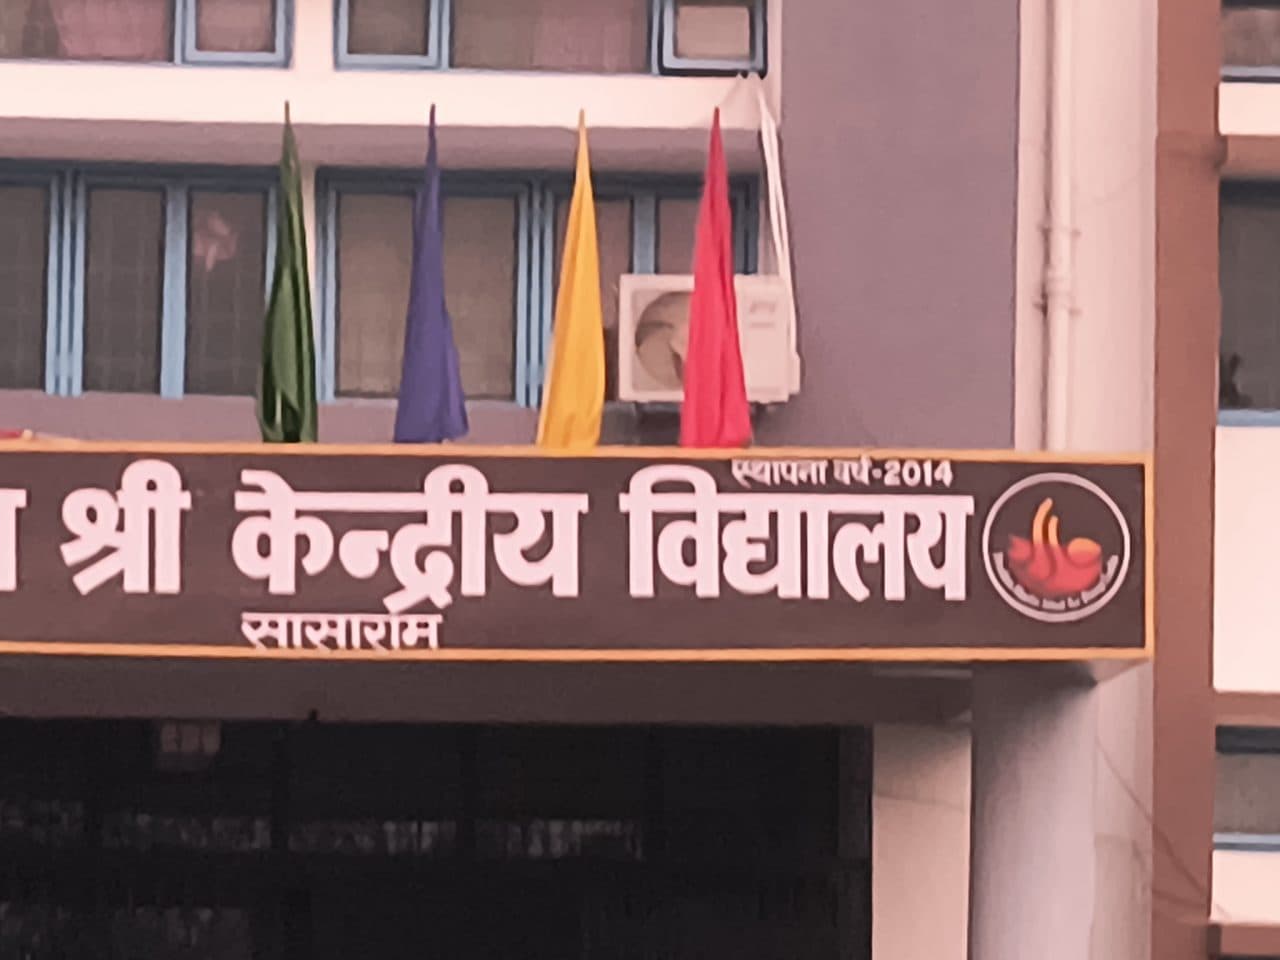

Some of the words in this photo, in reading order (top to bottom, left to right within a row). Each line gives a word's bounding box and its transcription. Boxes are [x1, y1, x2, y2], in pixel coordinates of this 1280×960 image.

[59, 459, 192, 596] श्री
[231, 464, 589, 612] केन्द्रीय
[618, 464, 975, 602] विद्यालय
[240, 612, 443, 656] सासाराम
